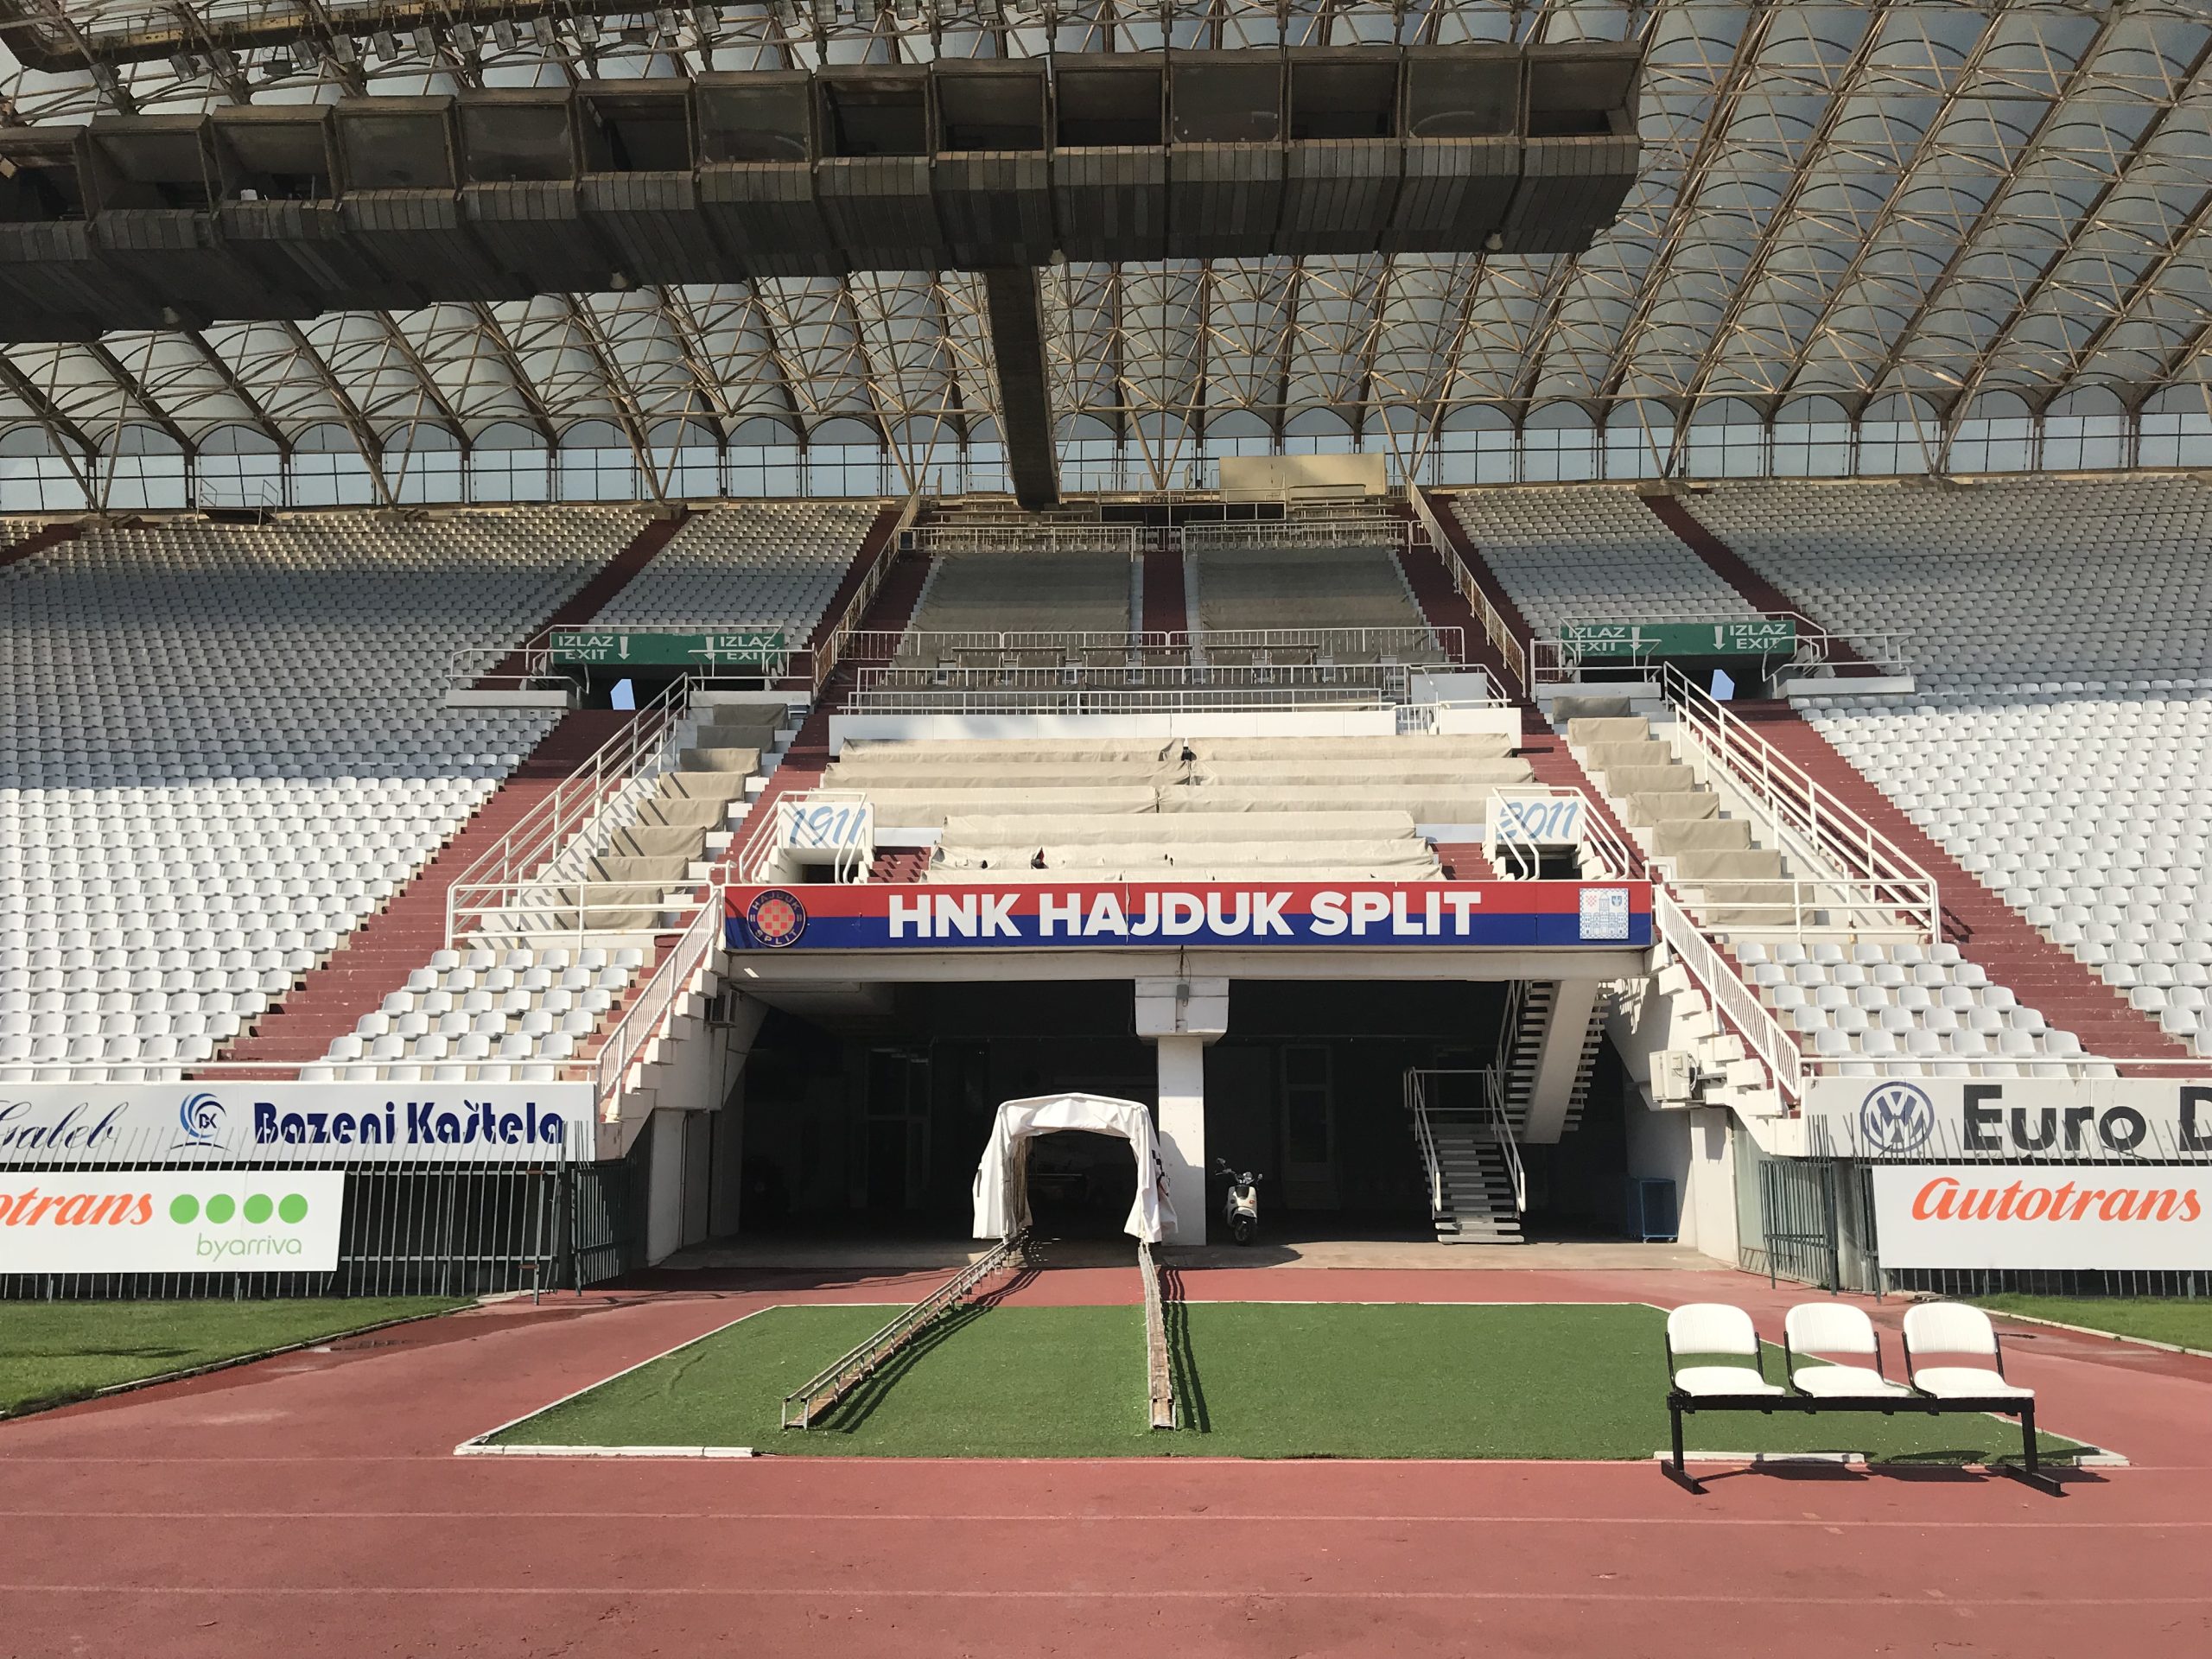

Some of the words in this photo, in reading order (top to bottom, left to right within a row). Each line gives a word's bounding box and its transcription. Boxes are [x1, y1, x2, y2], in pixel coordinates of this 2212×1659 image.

[1568, 627, 1625, 638] IZLAZ
[1729, 624, 1786, 636] IZLAZ
[558, 636, 613, 646] IZLAZ
[720, 636, 775, 647] IZLAZ
[1736, 638, 1781, 649] EXIT
[565, 649, 607, 659] EXIT
[727, 652, 766, 660] EXI
[790, 806, 866, 844] 1911
[752, 892, 800, 911] HAJDUK
[889, 893, 1022, 938] HNK
[1039, 892, 1294, 937] HAJDUK
[1309, 891, 1481, 936] SPLIT
[755, 929, 797, 945] SPLIT
[254, 1101, 395, 1145] Bazeni
[407, 1099, 563, 1145] Kaštela
[1964, 1084, 2146, 1151] Euro
